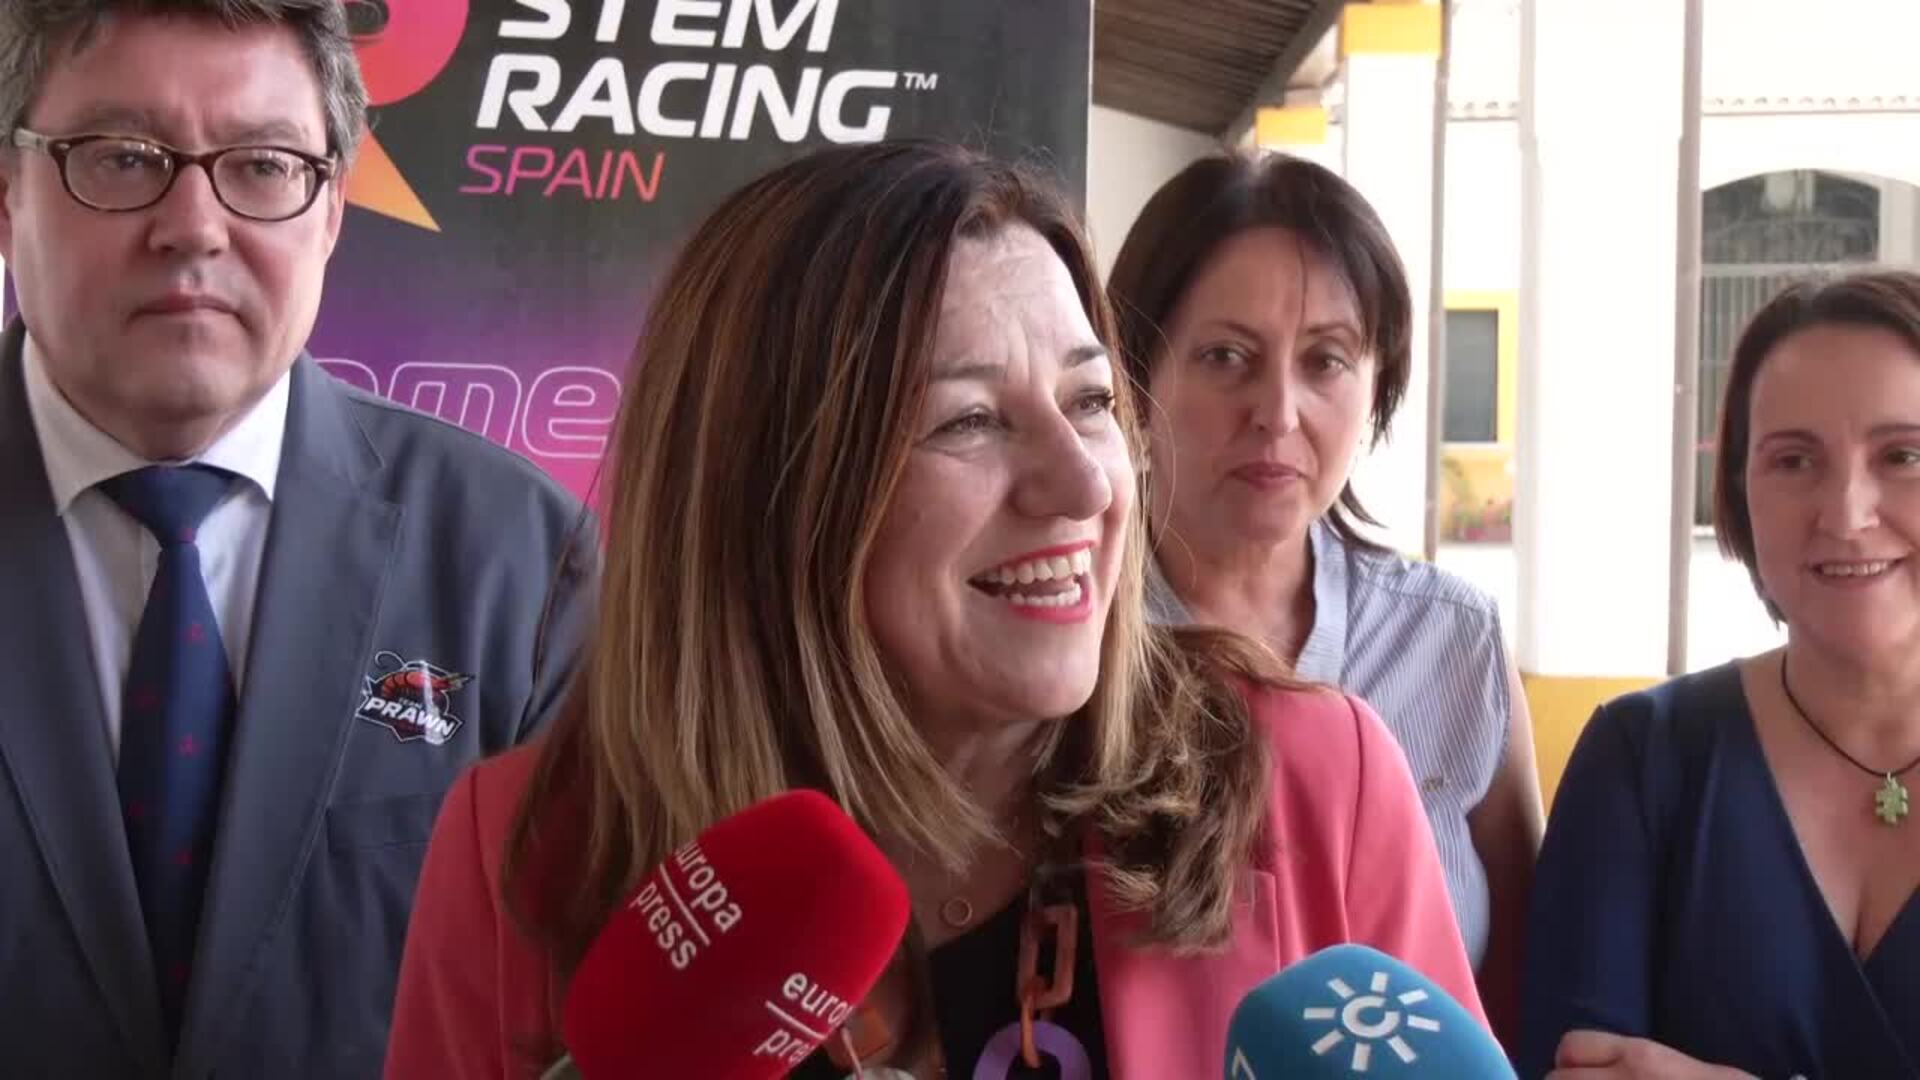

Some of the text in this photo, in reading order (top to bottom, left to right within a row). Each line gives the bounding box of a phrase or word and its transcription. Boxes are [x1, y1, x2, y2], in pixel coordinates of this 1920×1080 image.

[499, 0, 838, 52] STEM
[476, 54, 897, 143] RACING
[460, 144, 665, 201] SPAIN
[364, 697, 455, 736] PRAWN
[675, 841, 742, 933] uropa
[629, 881, 697, 969] press
[783, 972, 853, 1027] euro
